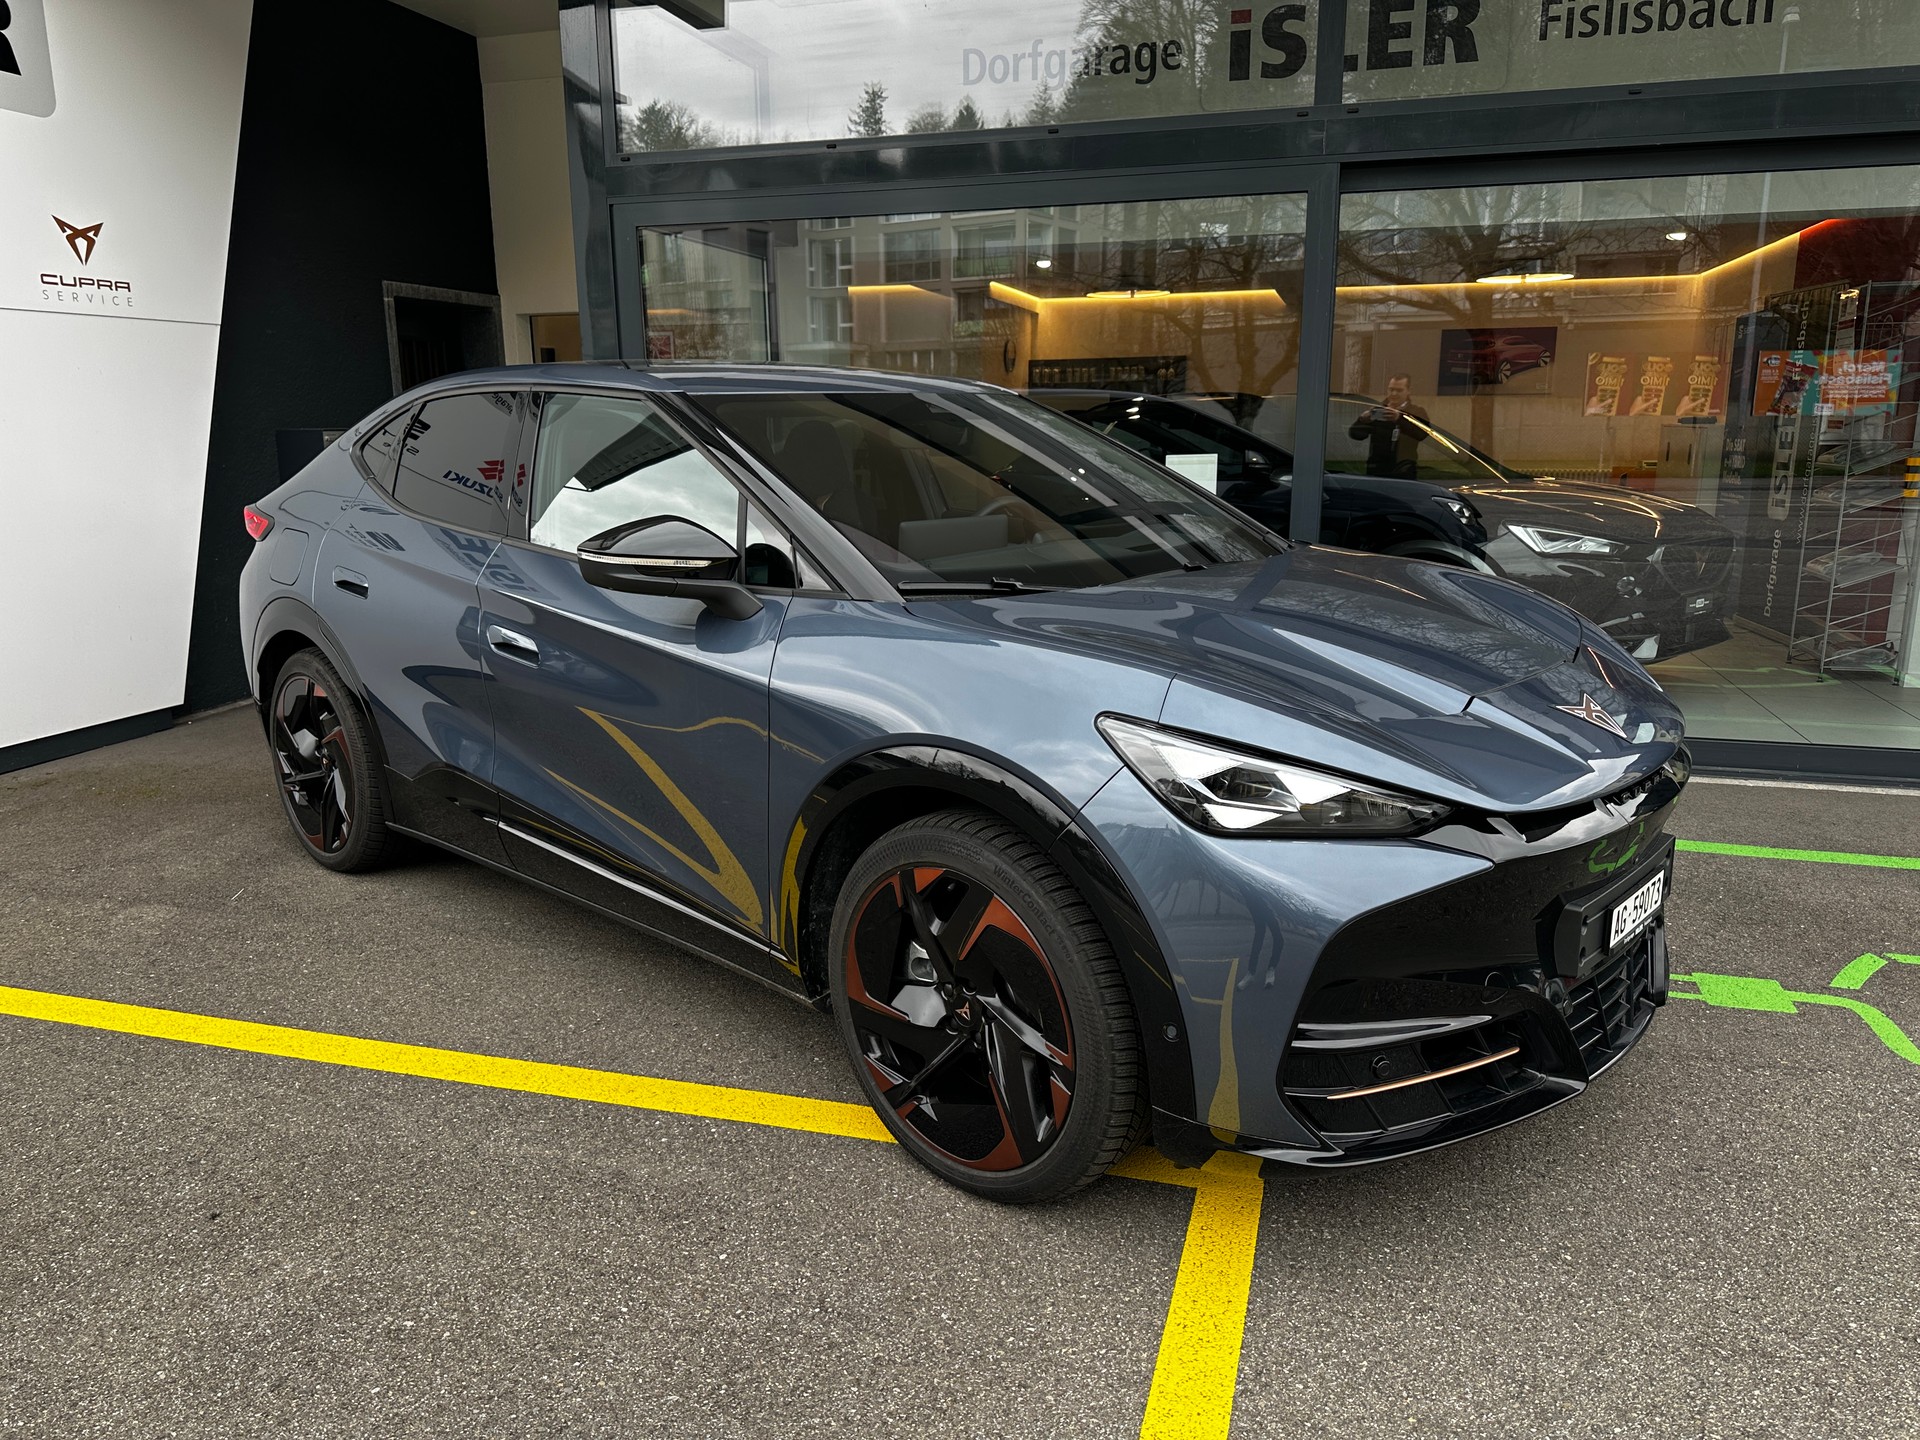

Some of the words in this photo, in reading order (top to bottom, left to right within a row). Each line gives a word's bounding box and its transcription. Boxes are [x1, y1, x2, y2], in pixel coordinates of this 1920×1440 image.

[962, 38, 1182, 91] Dorfgarage
[1229, 0, 1481, 82] iSER
[40, 273, 131, 293] CUPRA
[42, 289, 134, 307] SERVICE
[1763, 528, 1782, 617] Dorfgarage
[1791, 300, 1810, 381] Fislisbach
[993, 865, 1056, 936] WinterContact
